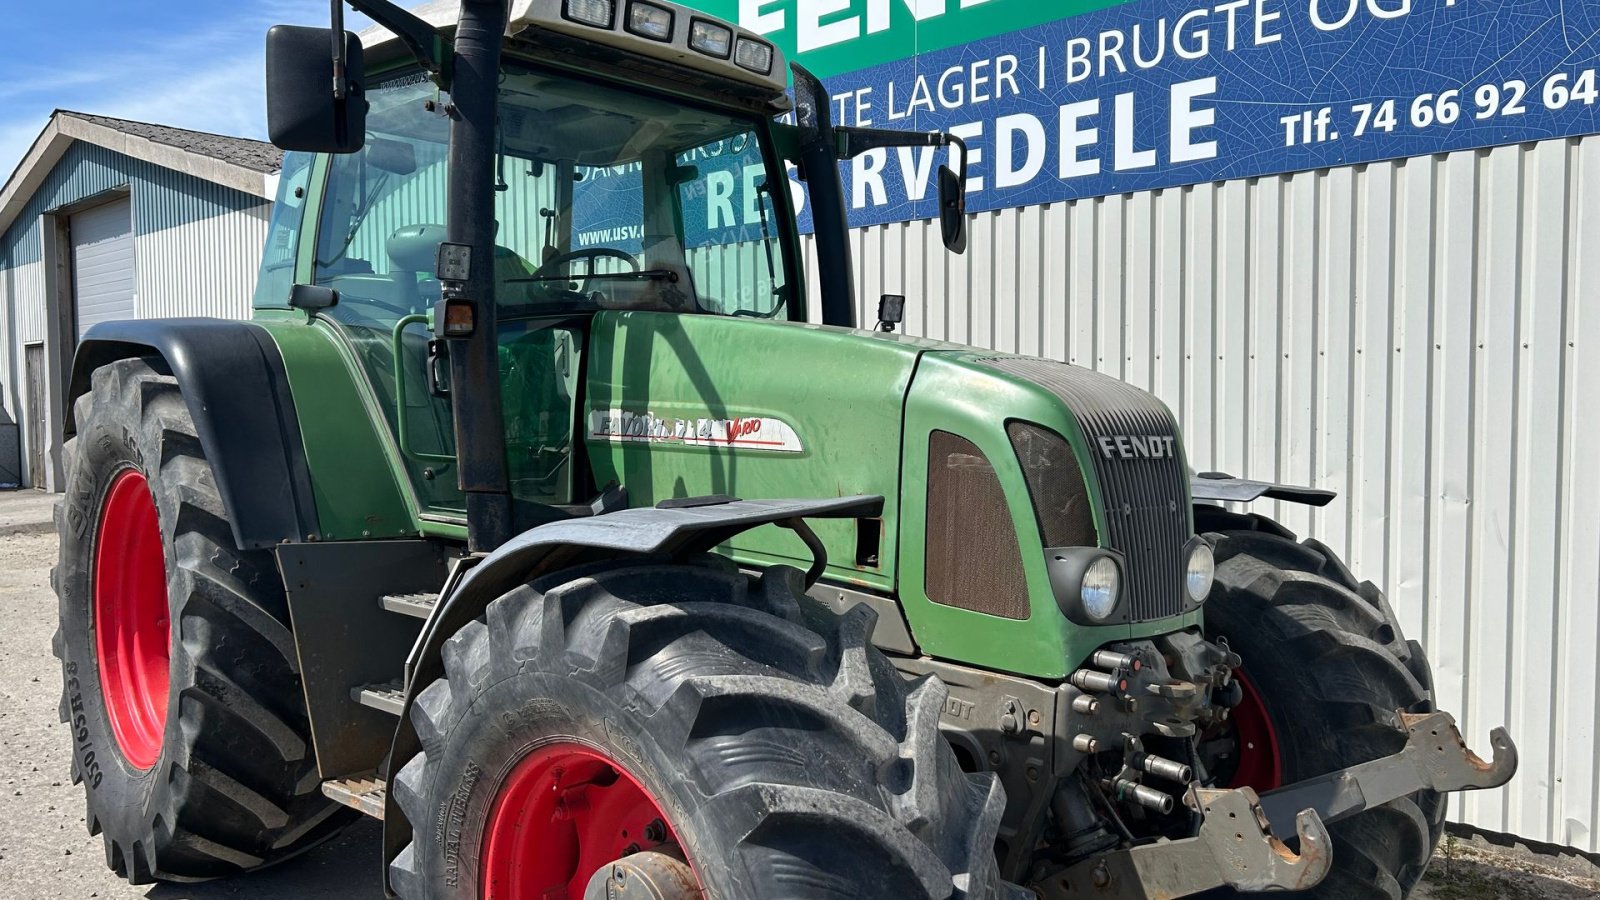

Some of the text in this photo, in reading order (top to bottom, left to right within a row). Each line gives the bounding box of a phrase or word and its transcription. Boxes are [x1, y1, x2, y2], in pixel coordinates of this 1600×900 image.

[888, 54, 1020, 120] LAGER
[1038, 46, 1046, 90] I
[1066, 0, 1282, 84] BRUGTE
[1280, 69, 1599, 147] Tlf. 74 66 92 64
[578, 224, 645, 246] www.usv.
[1097, 435, 1174, 459] FENDT
[446, 760, 481, 888] RADIAL TUBELESS
